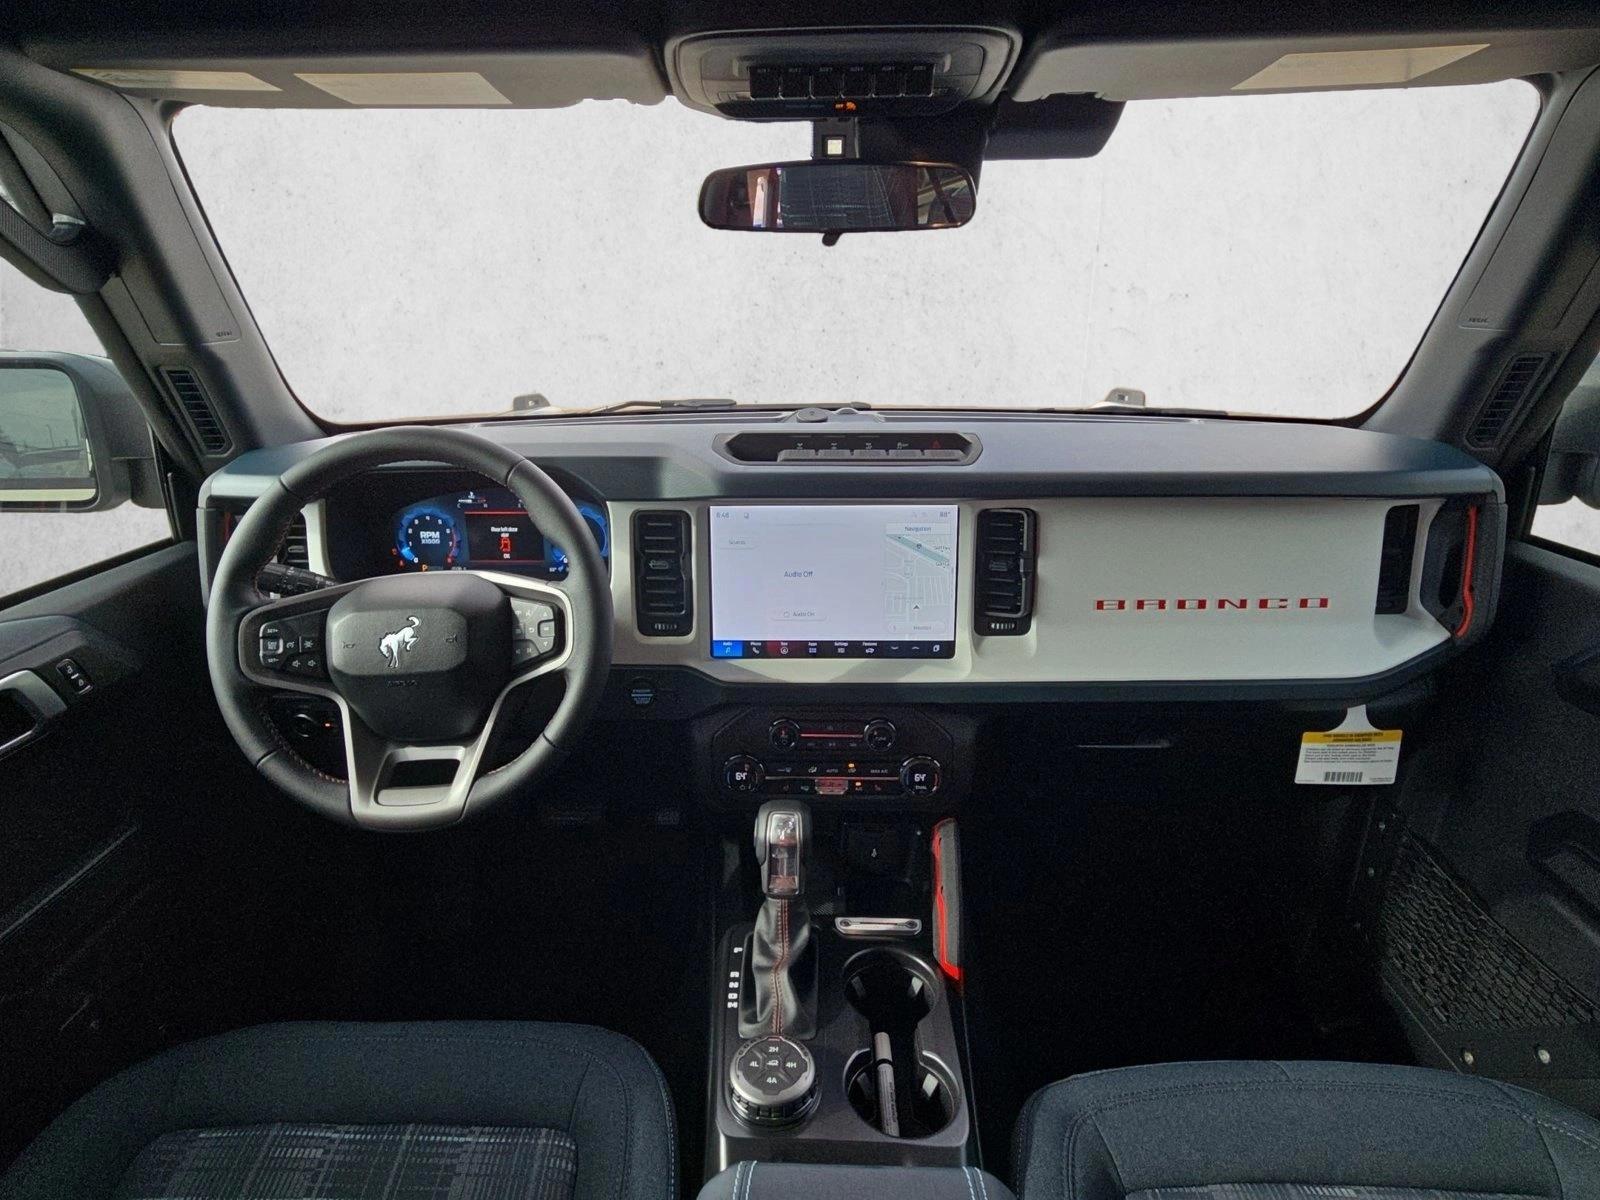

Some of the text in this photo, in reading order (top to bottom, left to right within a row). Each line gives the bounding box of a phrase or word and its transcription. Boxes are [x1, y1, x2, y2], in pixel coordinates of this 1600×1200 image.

[420, 531, 440, 539] RPM
[784, 570, 814, 578] Audio Off
[1096, 598, 1329, 610] BRONCO
